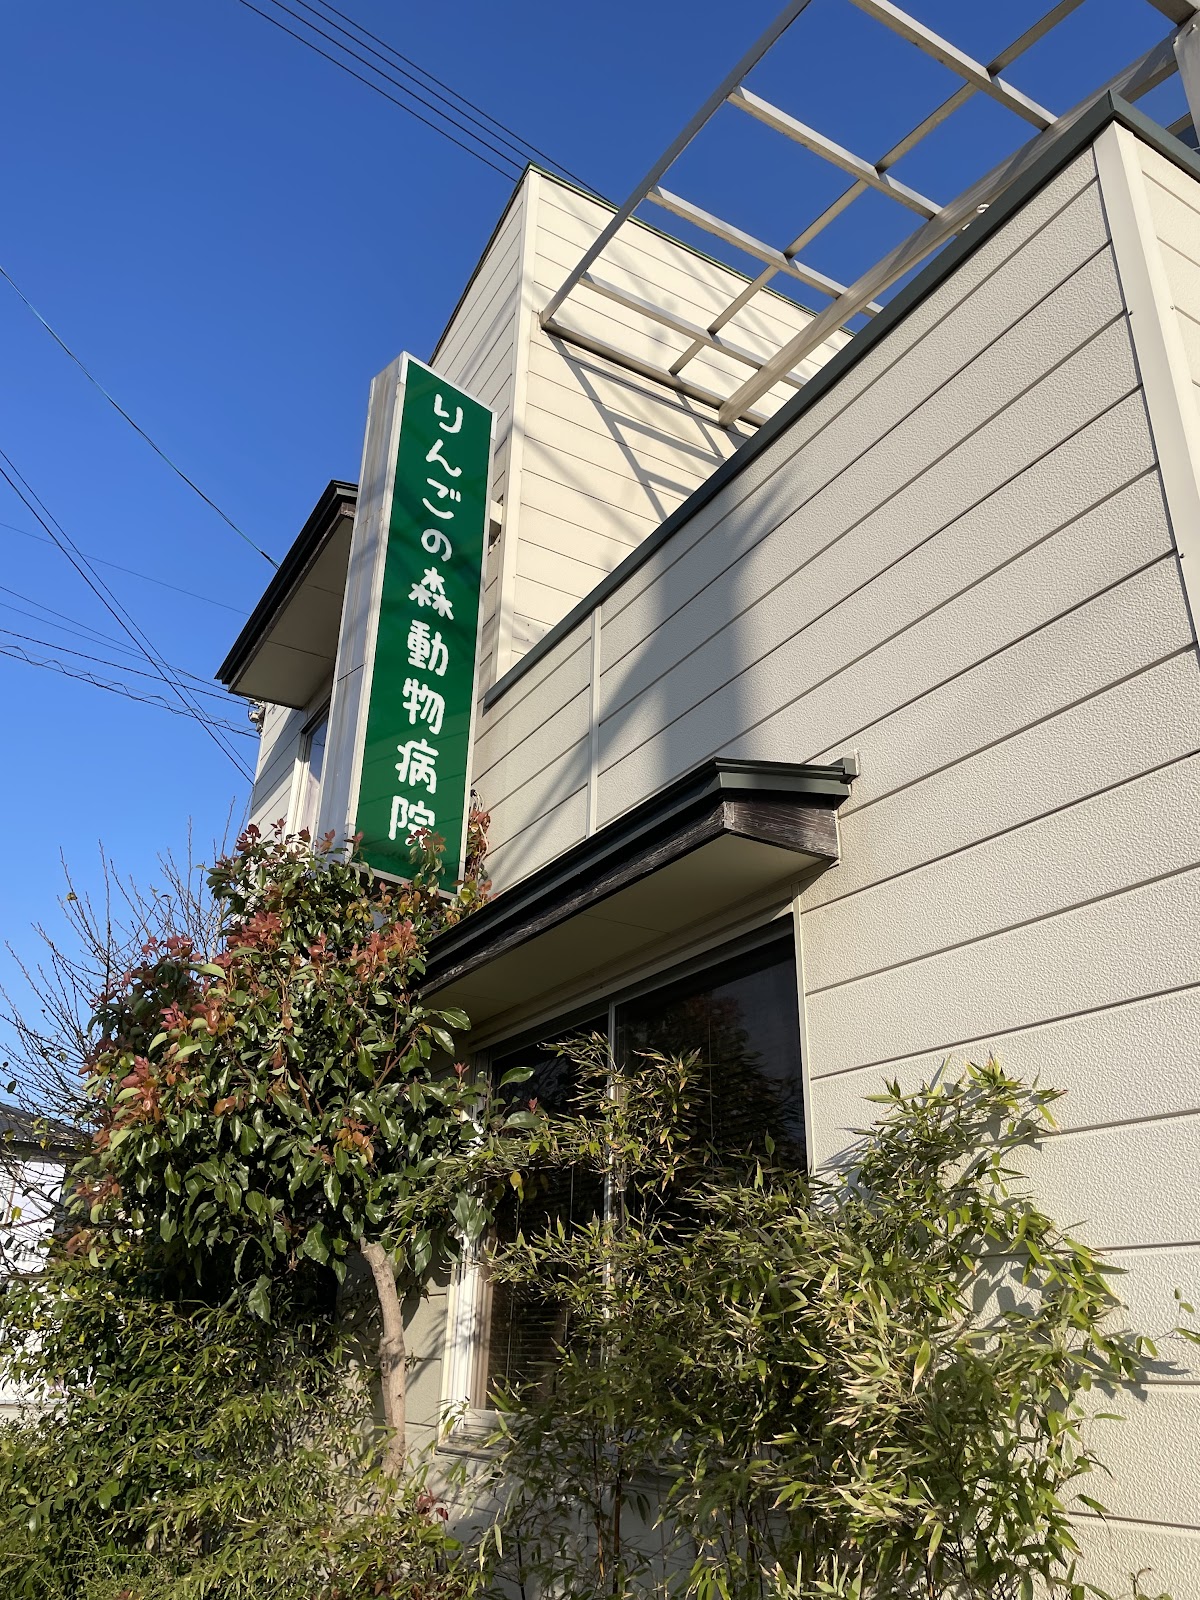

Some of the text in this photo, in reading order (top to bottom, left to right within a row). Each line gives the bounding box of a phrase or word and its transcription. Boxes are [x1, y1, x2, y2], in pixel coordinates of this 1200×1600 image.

[388, 393, 464, 851] りんごの森動物病院
